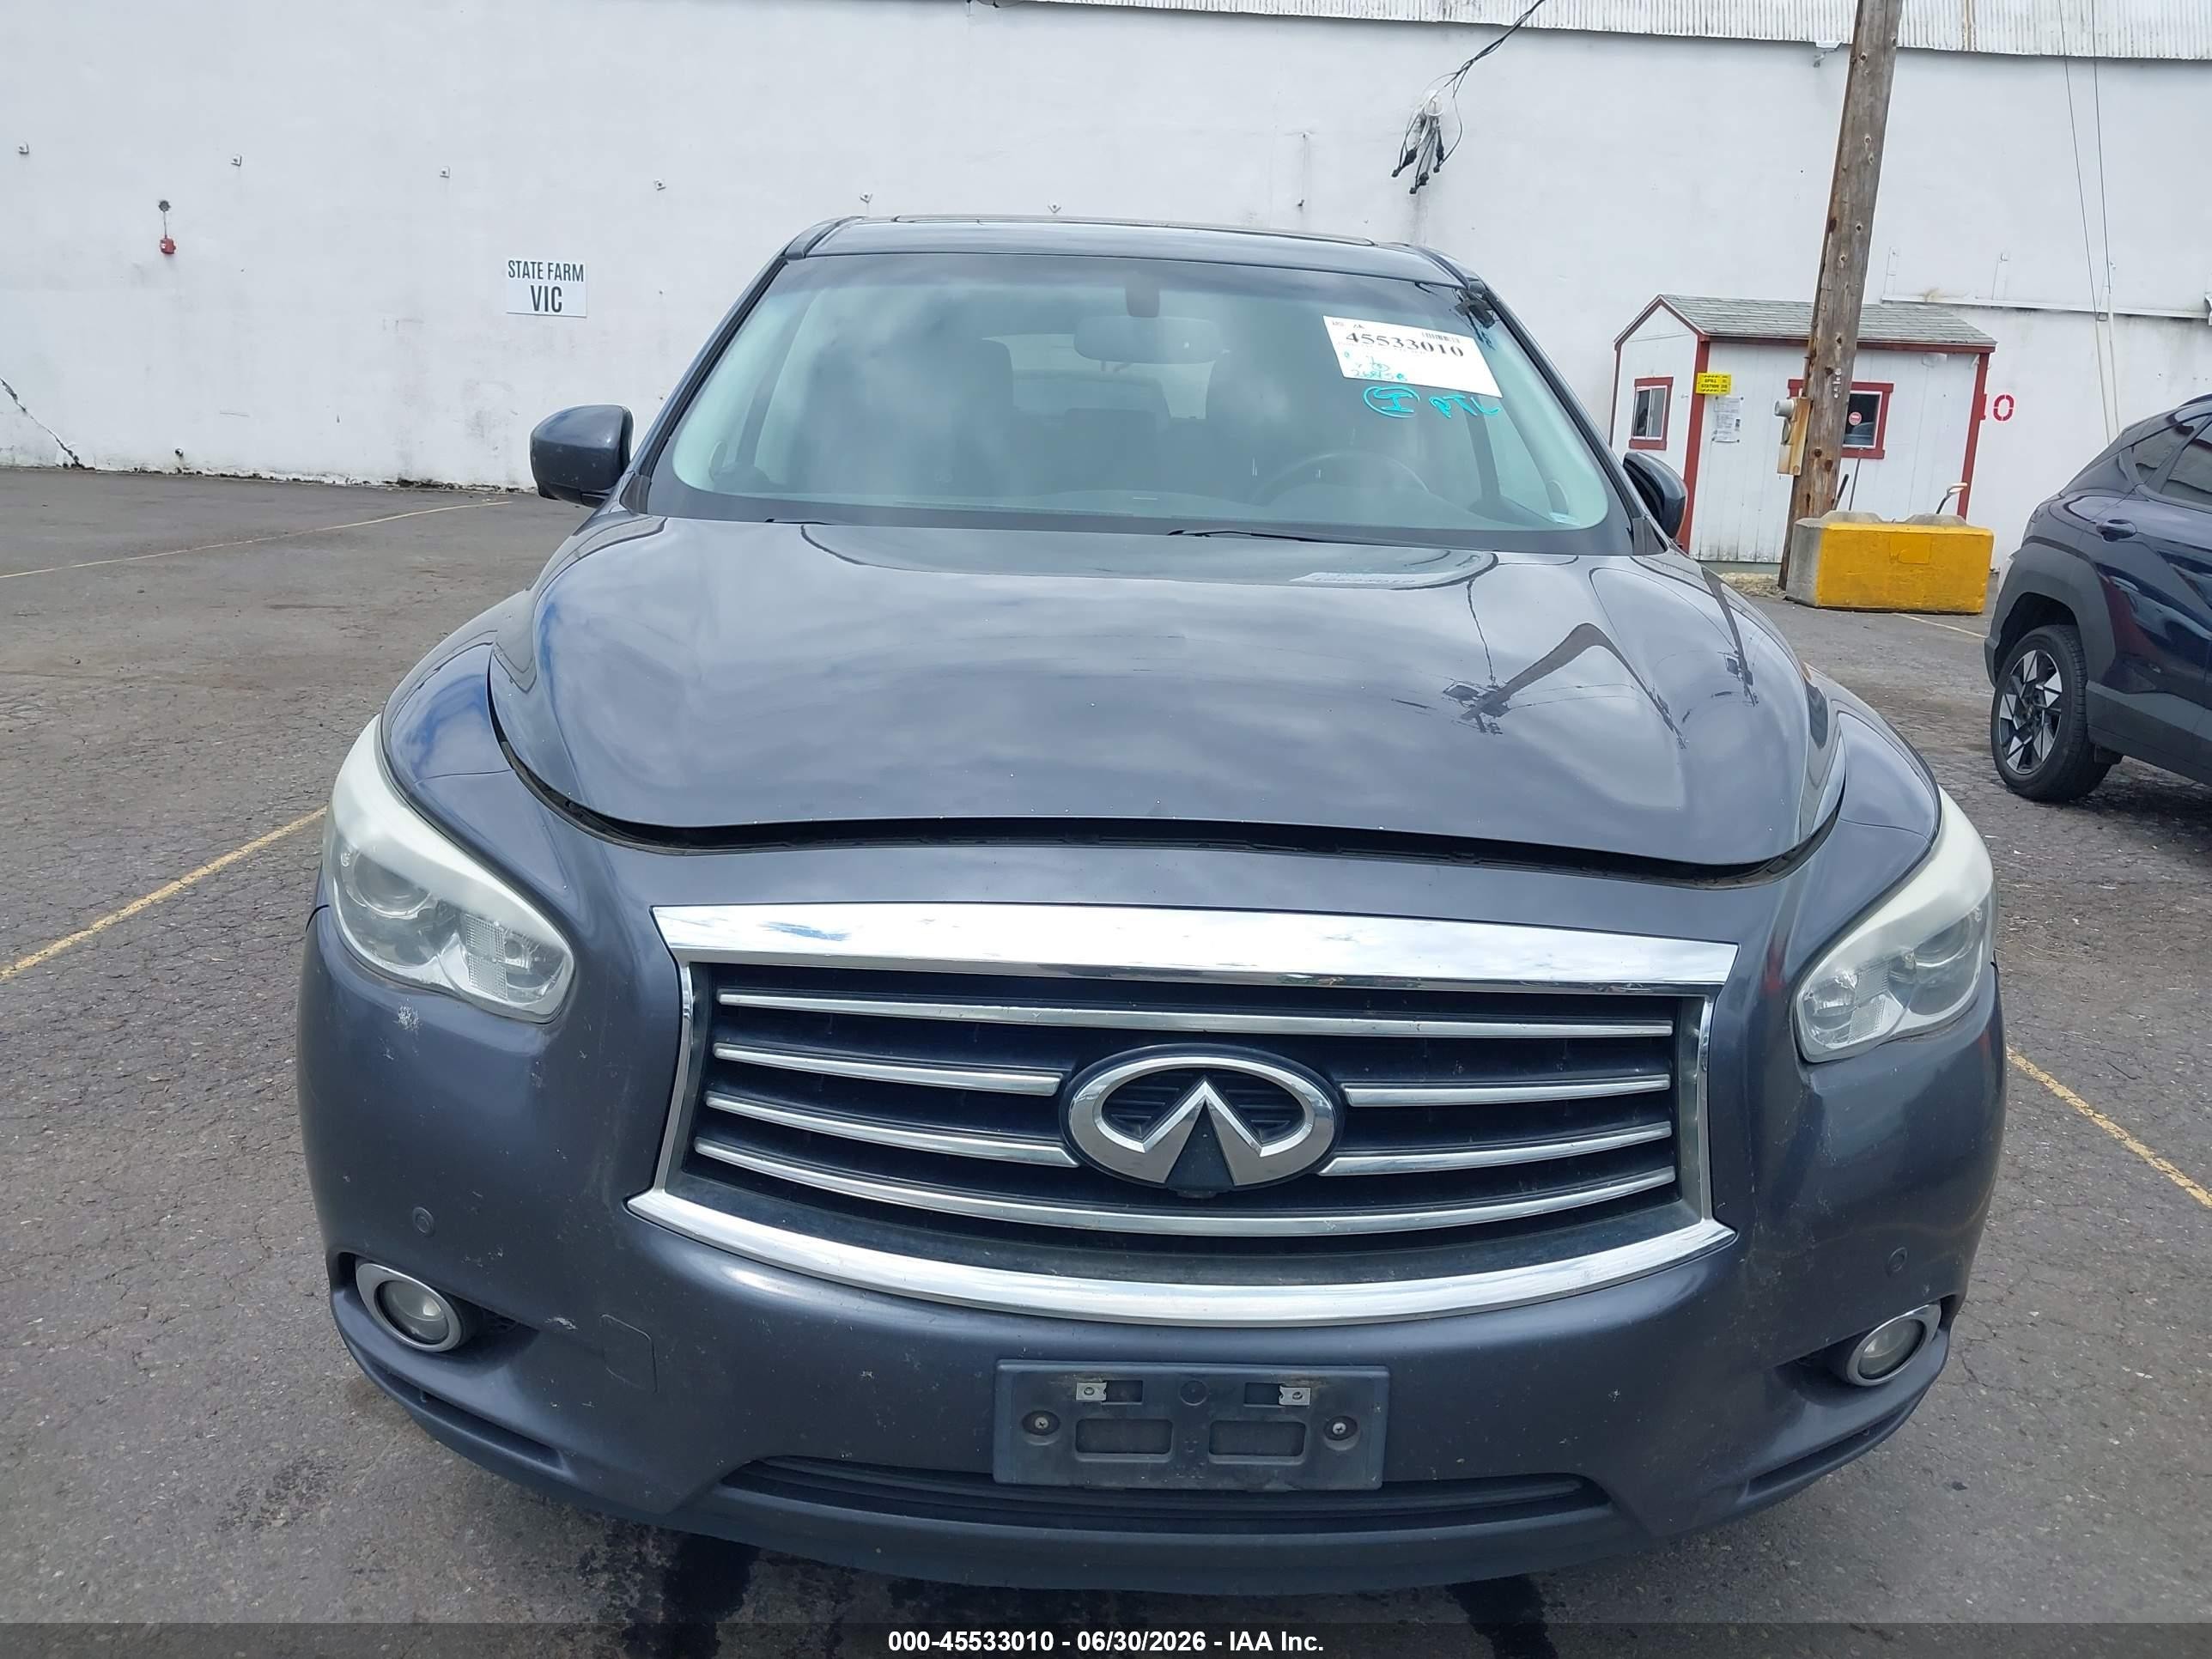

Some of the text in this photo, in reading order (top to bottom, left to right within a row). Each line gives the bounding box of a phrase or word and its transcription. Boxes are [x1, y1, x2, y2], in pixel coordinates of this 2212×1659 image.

[508, 260, 584, 282] STATE FARM
[531, 285, 562, 313] VIC
[1346, 331, 1464, 357] 45533010
